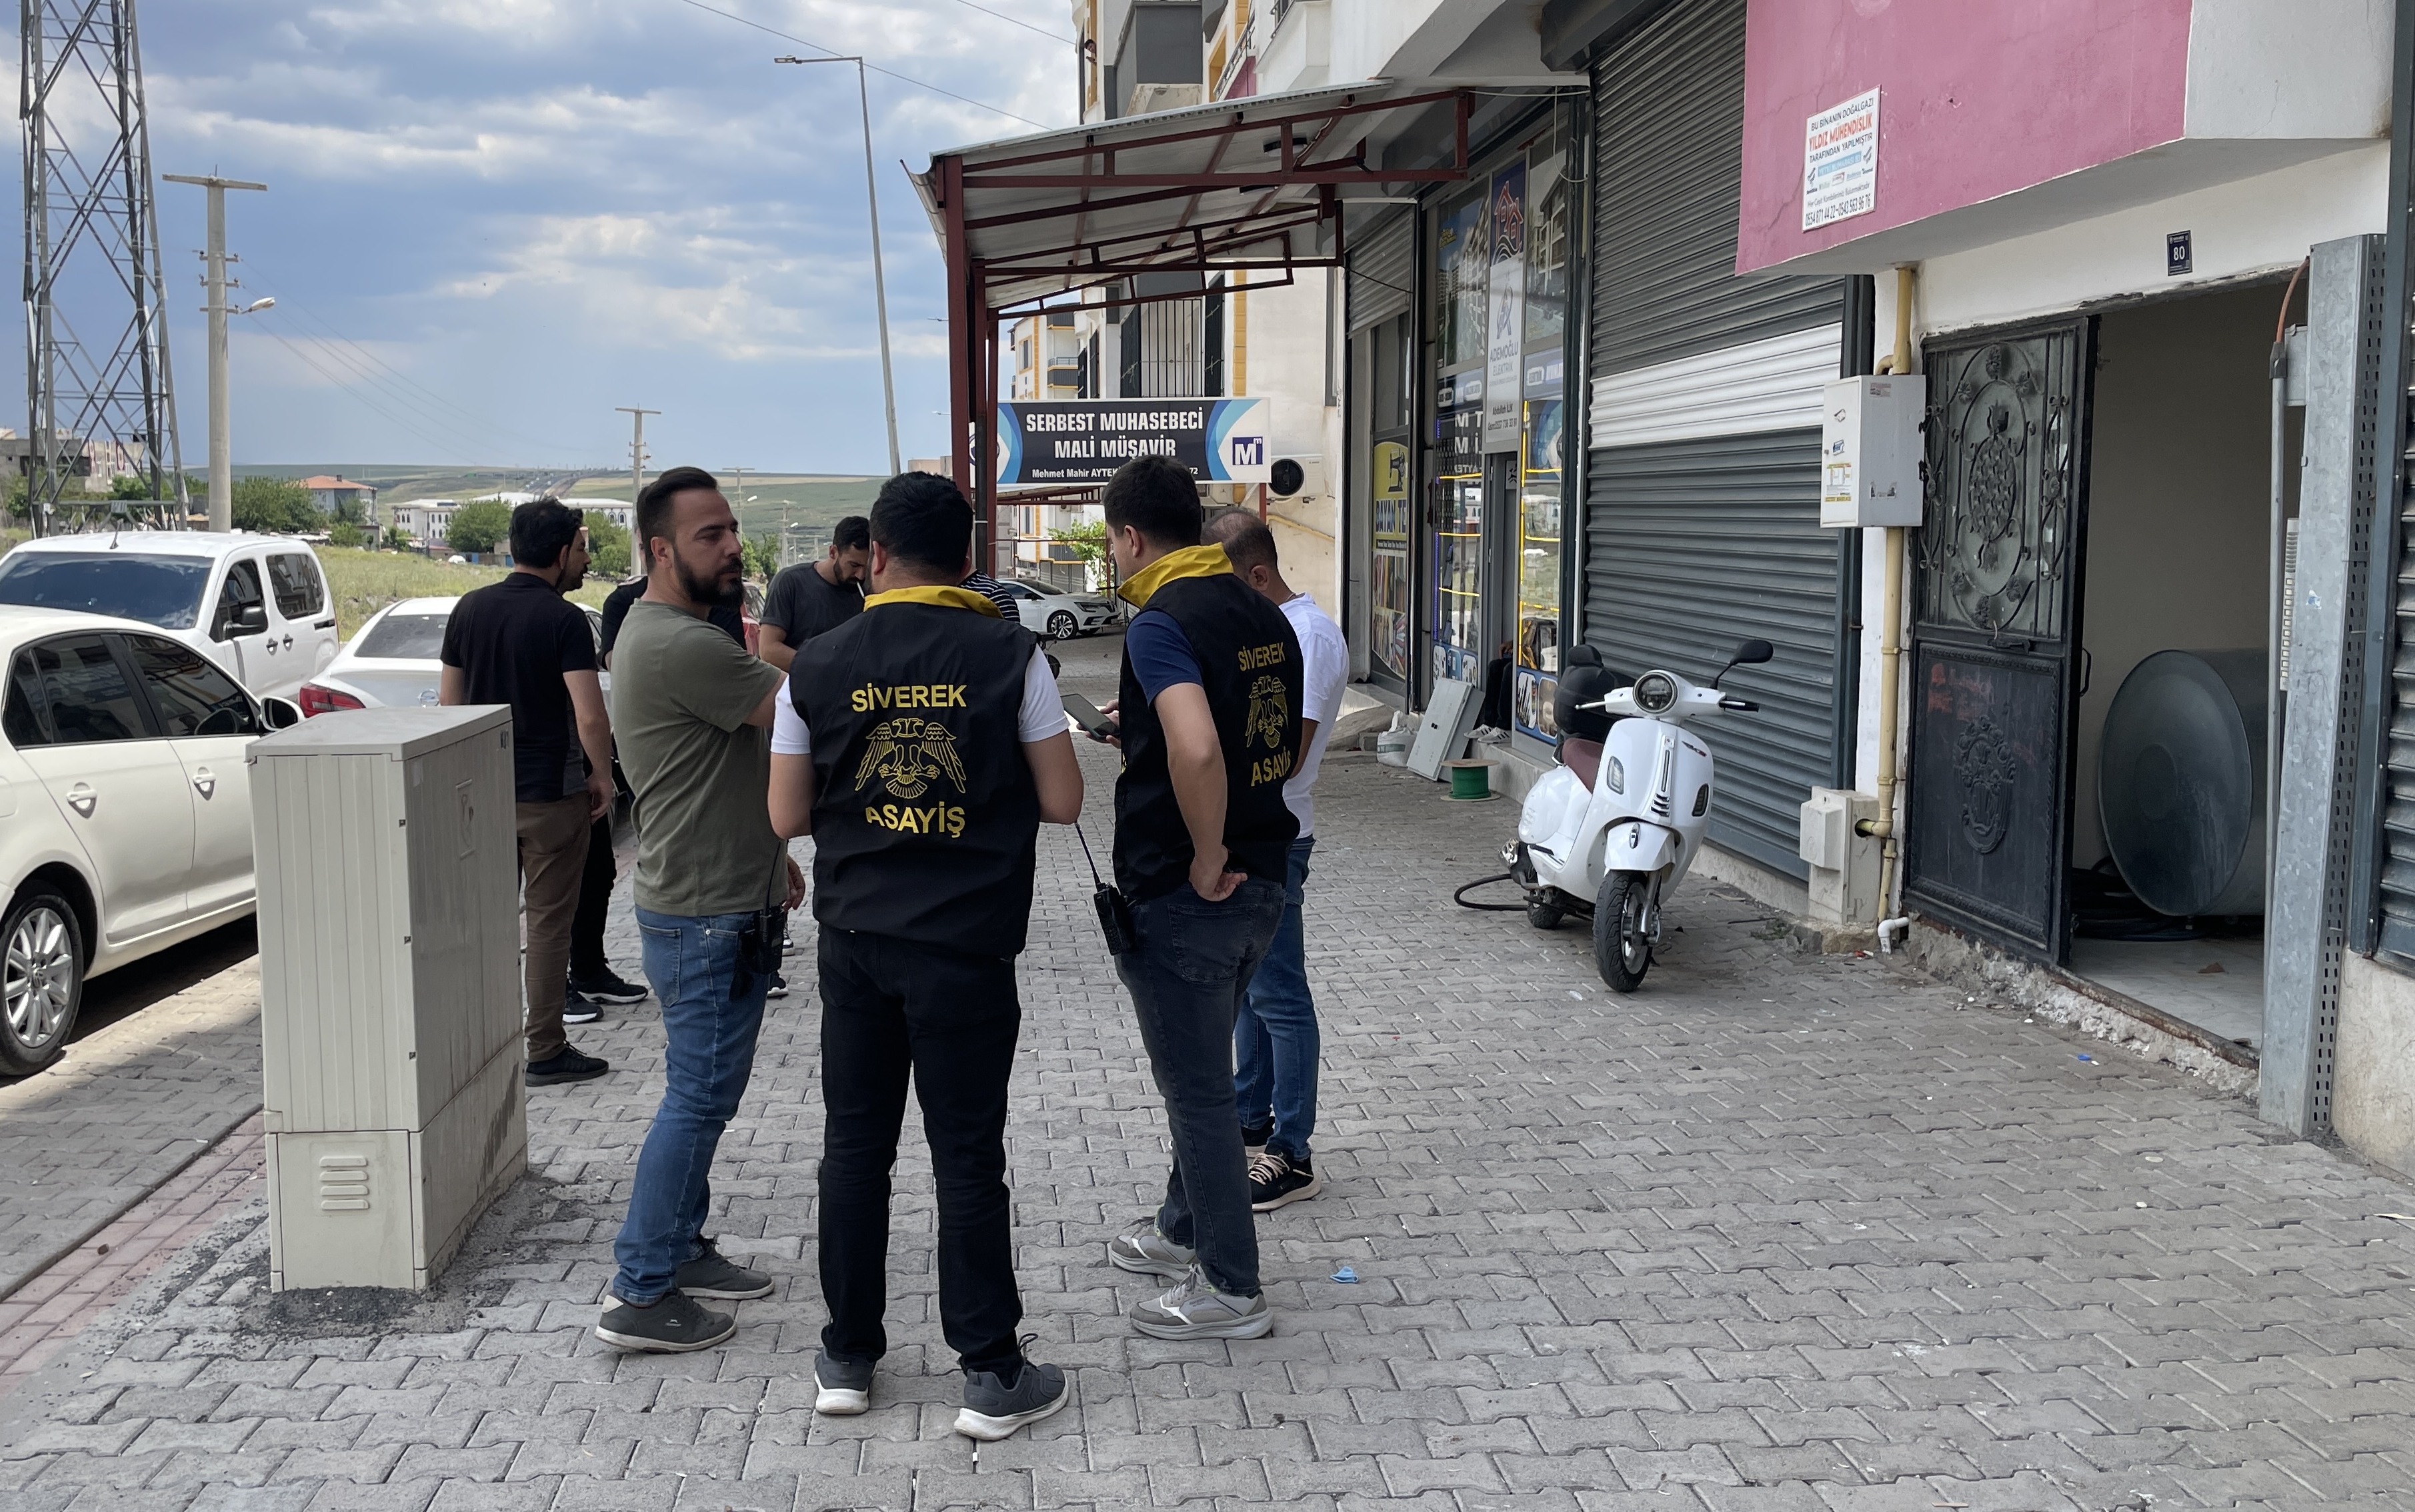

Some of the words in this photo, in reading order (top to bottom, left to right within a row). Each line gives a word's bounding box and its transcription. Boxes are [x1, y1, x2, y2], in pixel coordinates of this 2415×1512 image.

[1811, 121, 1819, 131] BU
[1842, 97, 1874, 119] DOĞALGAZI
[1809, 131, 1828, 151] YILDIZ
[1809, 145, 1840, 163] TARAFINDAN
[2173, 245, 2186, 261] 80
[1025, 413, 1095, 432] SERBEST
[1099, 406, 1203, 431] MUHASEBECİ
[1054, 435, 1095, 459] MALİ
[1101, 434, 1176, 460] MÜŞAVİR
[1032, 469, 1065, 479] Mehmet
[1066, 468, 1089, 478] Mahir
[1091, 466, 1121, 477] AYTEK
[1376, 499, 1396, 533] BAYAN
[1238, 642, 1286, 671] SİVEREK
[851, 683, 967, 712] SİVEREK
[865, 801, 965, 838] ASAYİŞ
